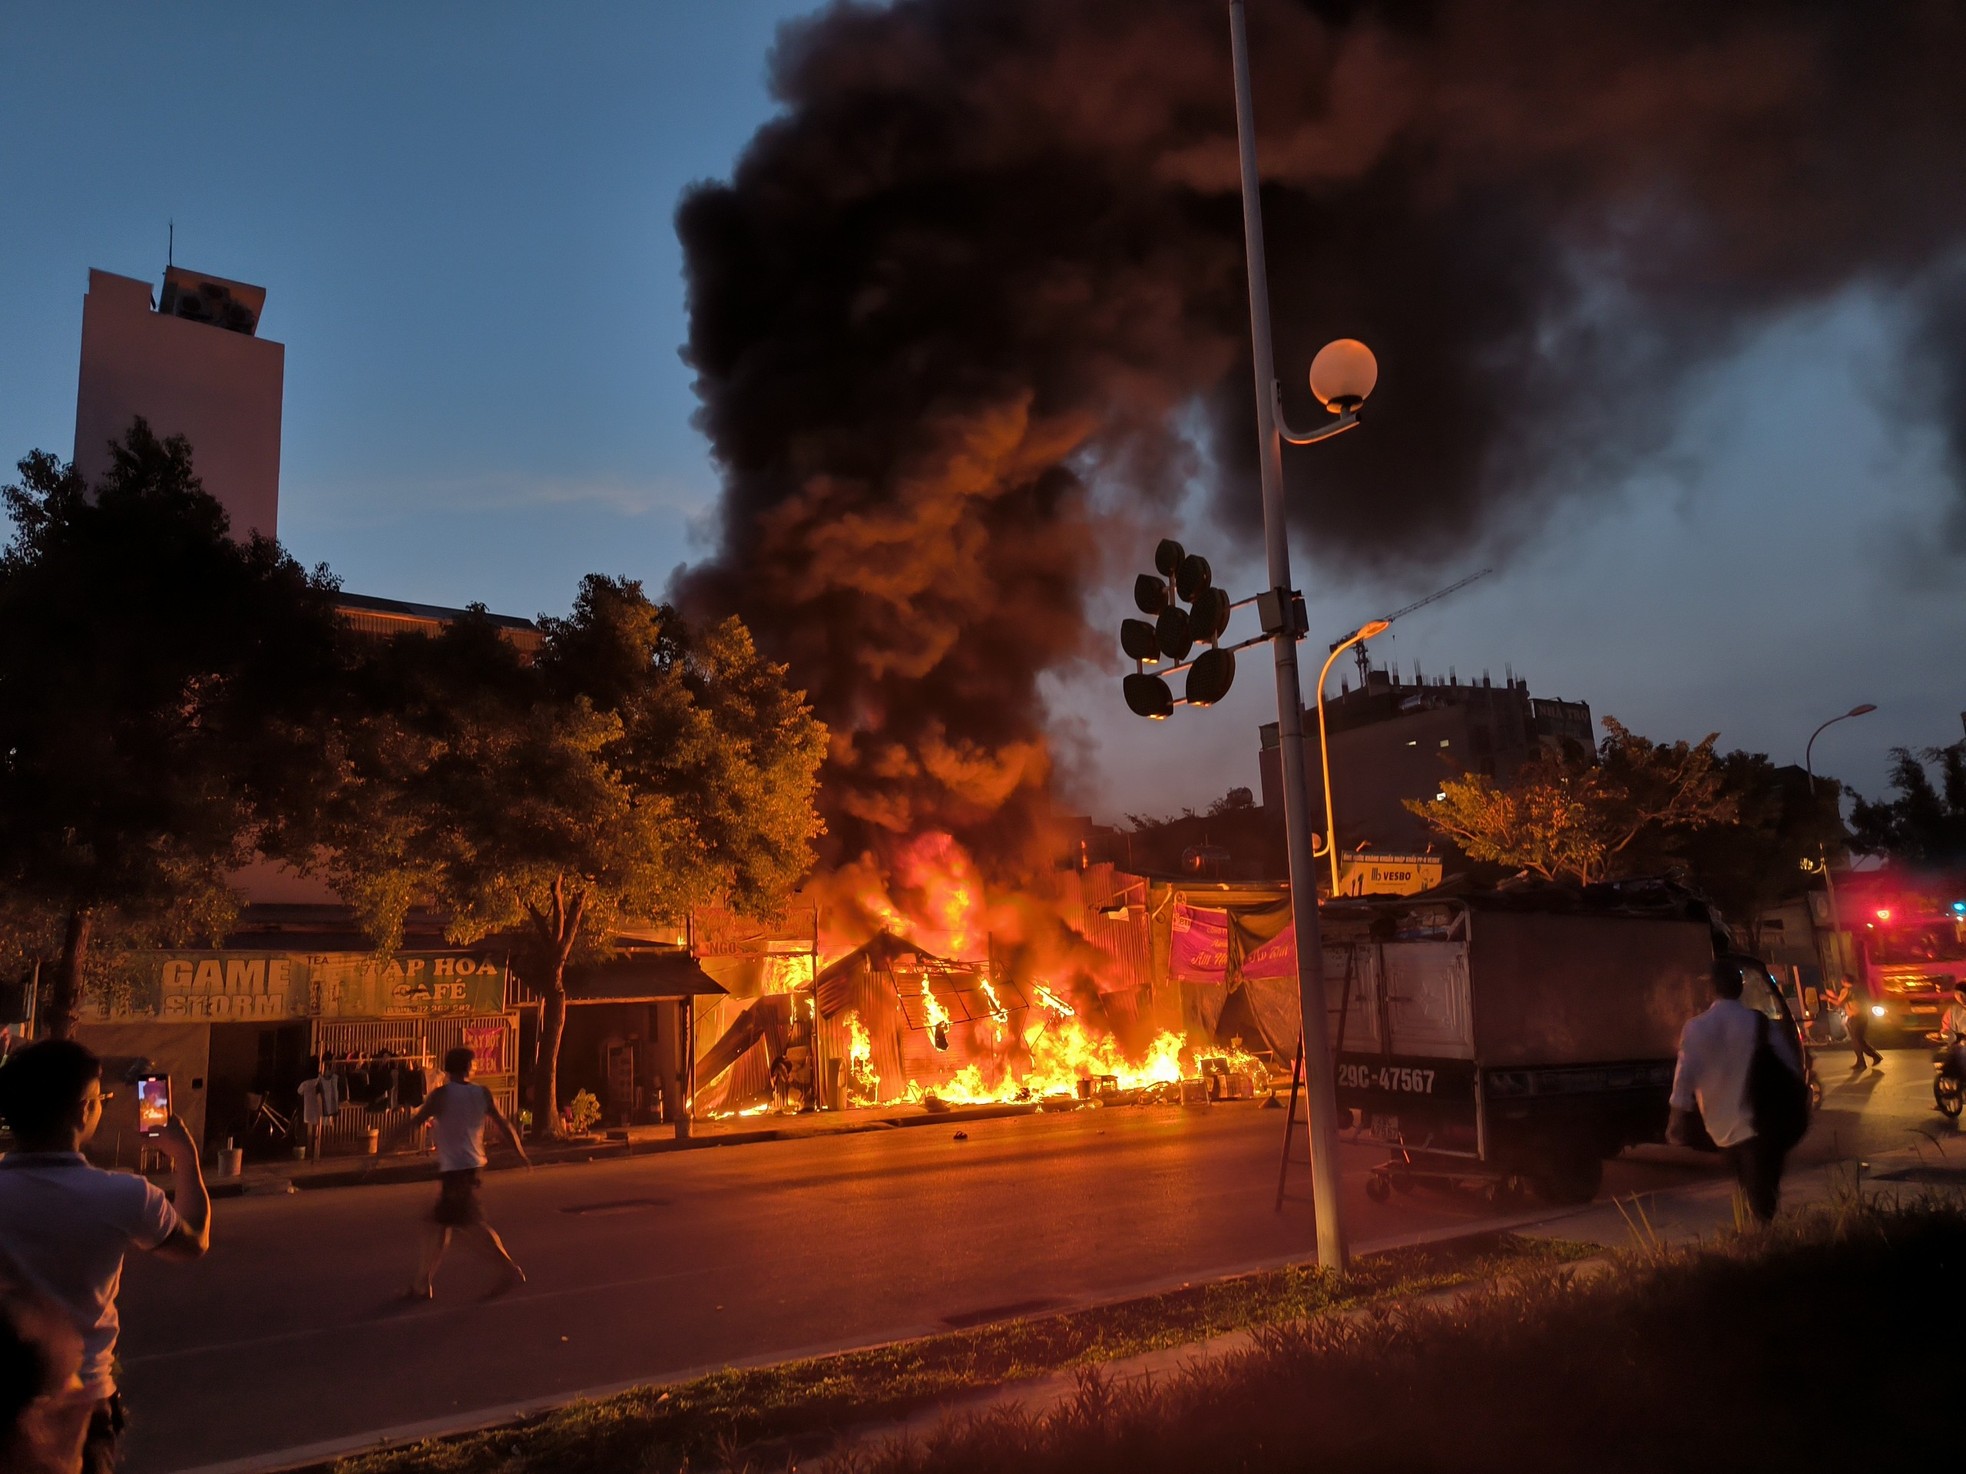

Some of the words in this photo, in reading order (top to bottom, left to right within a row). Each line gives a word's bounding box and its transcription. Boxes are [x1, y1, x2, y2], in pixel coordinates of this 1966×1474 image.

[1383, 871, 1411, 881] VESBO
[306, 955, 329, 965] TEA
[162, 959, 290, 994] GAME
[392, 978, 467, 1001] CAFÉ
[164, 994, 284, 1017] STORM
[1338, 1063, 1435, 1094] 29C-47567
